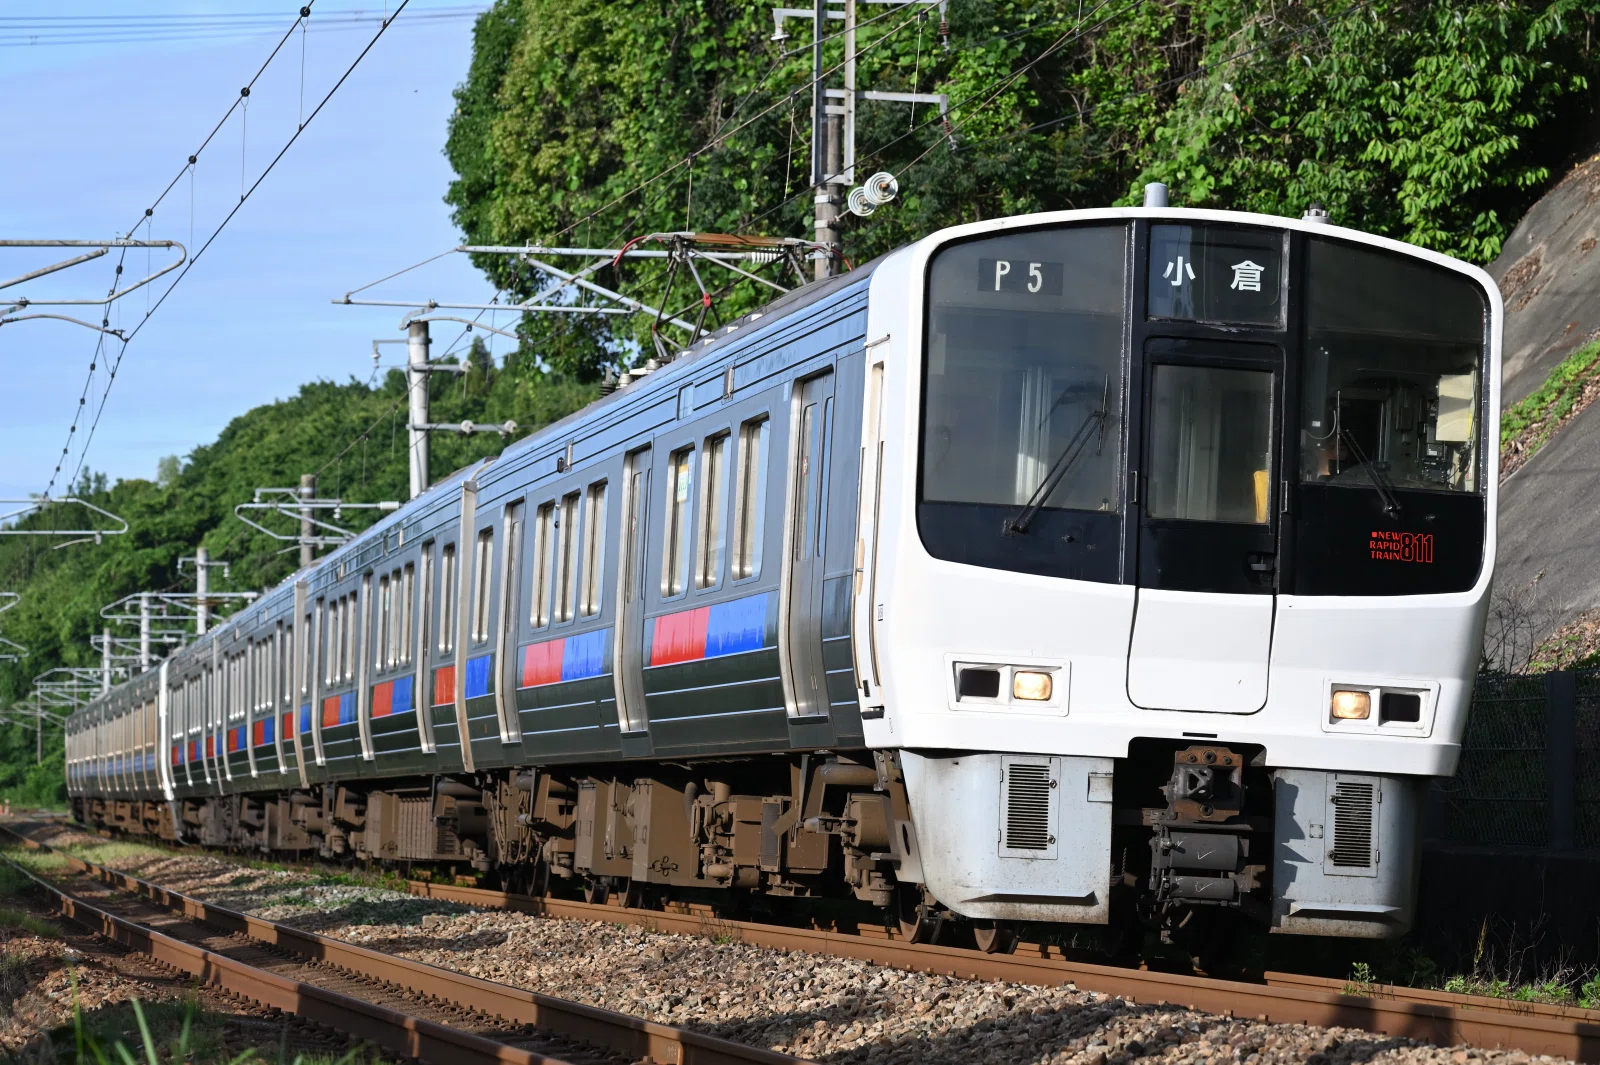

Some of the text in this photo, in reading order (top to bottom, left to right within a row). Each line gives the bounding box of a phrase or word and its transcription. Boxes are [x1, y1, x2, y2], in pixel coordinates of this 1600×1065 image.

[1162, 256, 1265, 292] 小倉
[1378, 531, 1400, 541] NEW
[1369, 540, 1400, 551] RAPID
[1400, 532, 1433, 563] 811
[1370, 550, 1400, 560] TRAIN
